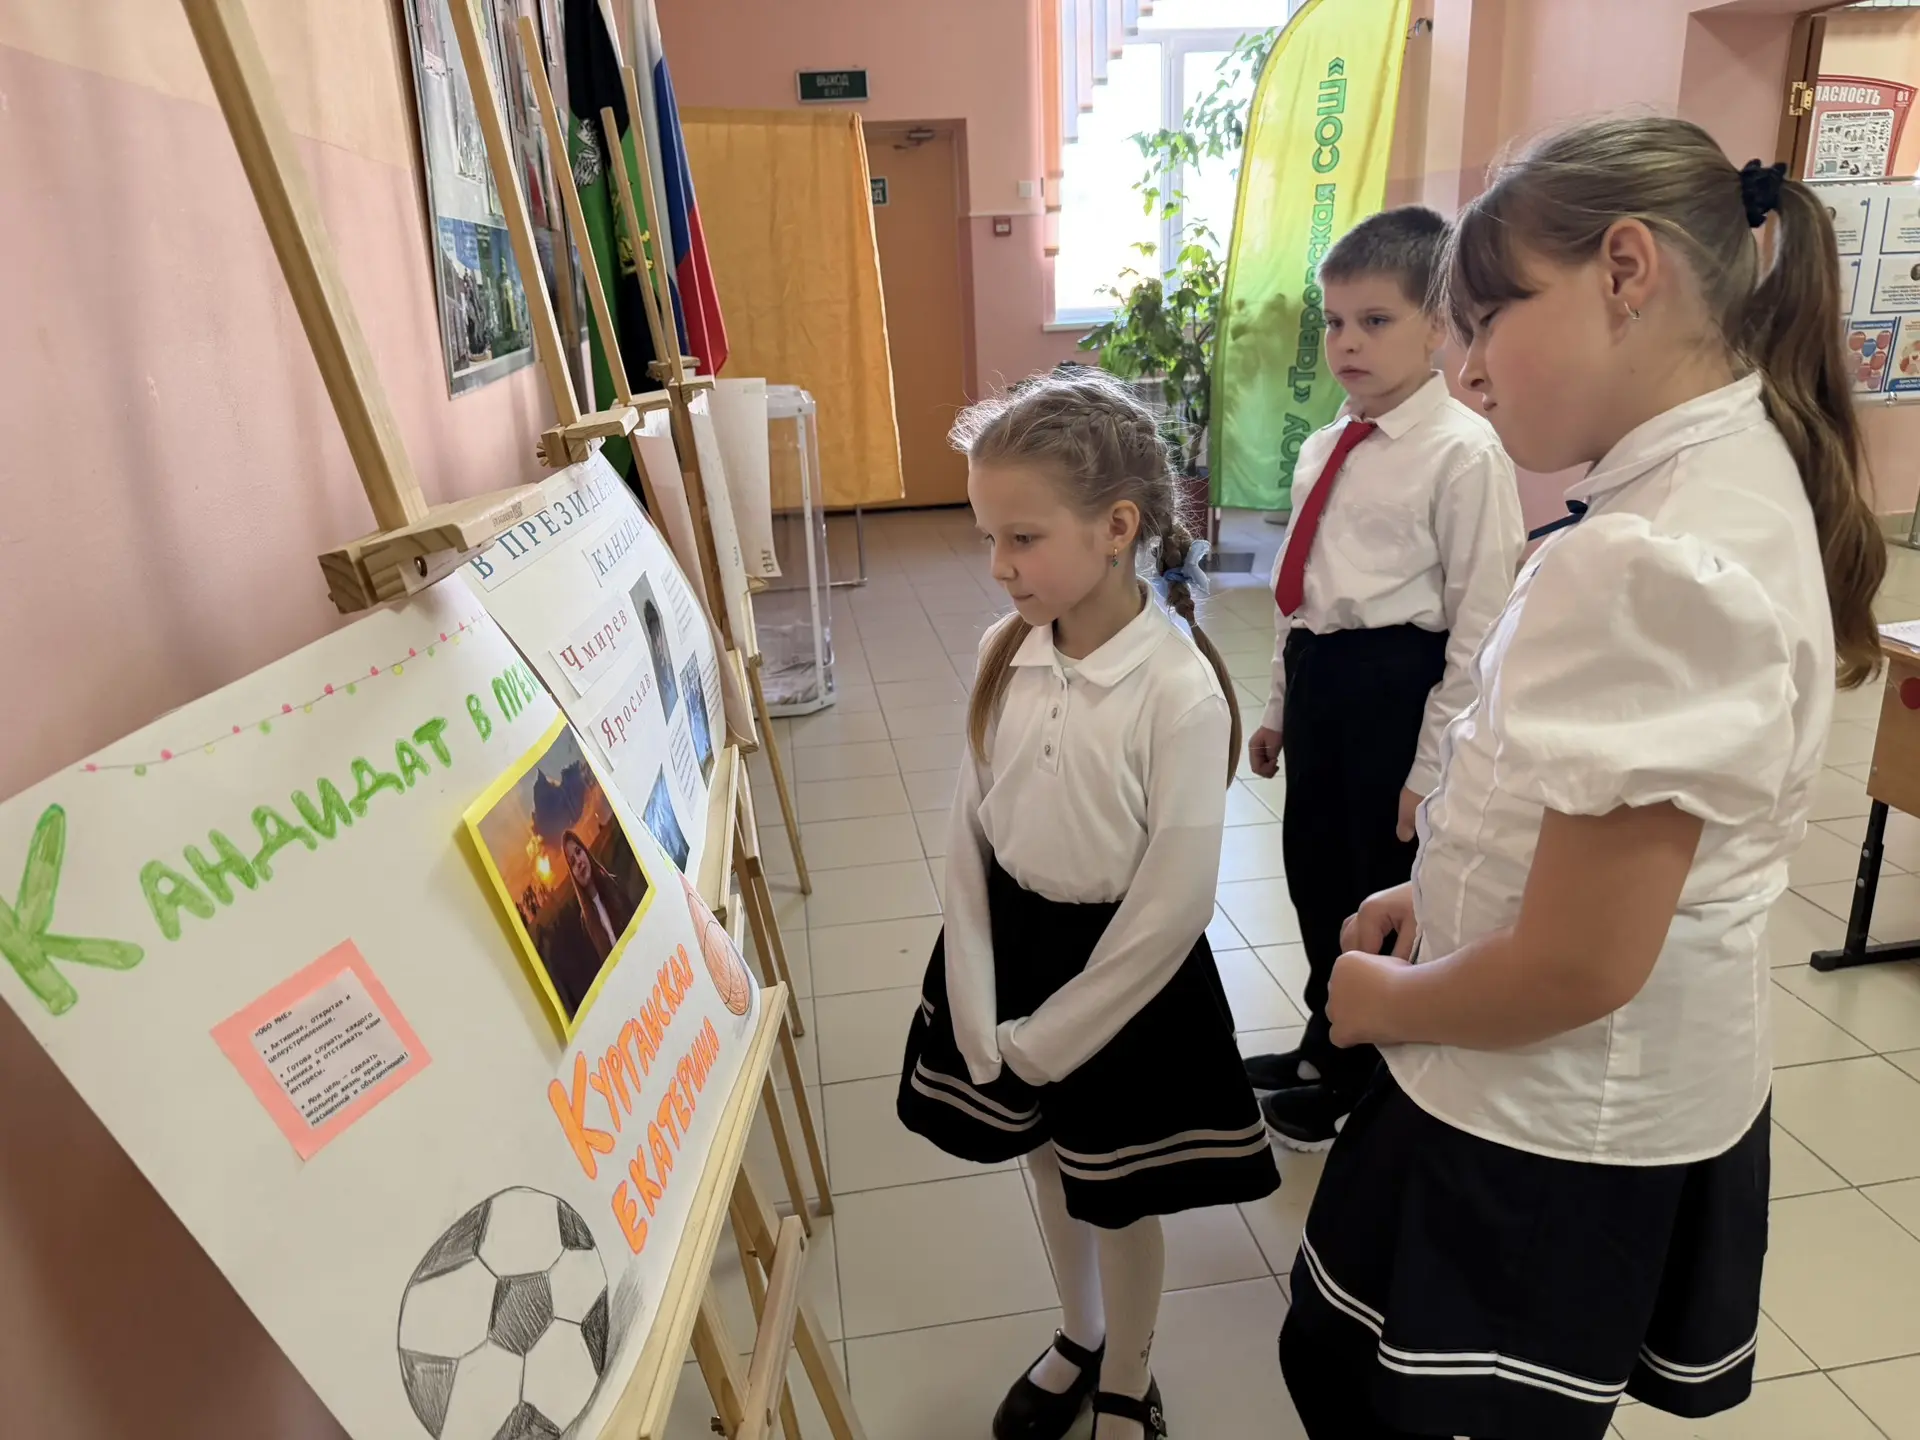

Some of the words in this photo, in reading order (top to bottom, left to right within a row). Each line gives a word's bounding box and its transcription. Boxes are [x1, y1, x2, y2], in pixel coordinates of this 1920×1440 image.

[816, 74, 849, 87] ВЫХОД
[1312, 57, 1347, 174] СОШ»
[469, 552, 494, 580] В
[560, 609, 628, 671] Чмирев
[601, 673, 652, 749] Ярослав
[268, 1017, 336, 1064] целеустремленная.
[271, 1024, 308, 1051] Активная,
[310, 999, 343, 1024] открытая
[274, 1010, 293, 1024] МНЕ»
[286, 1054, 312, 1073] Готова
[314, 1034, 343, 1055] слушать
[345, 1012, 373, 1034] каждого
[284, 1065, 313, 1088] ученика
[323, 1030, 363, 1060] отстаивать
[365, 1017, 381, 1031] наши
[290, 1068, 326, 1095] интересы.
[308, 1092, 322, 1105] Моя
[324, 1080, 341, 1095] цель
[350, 1053, 378, 1075] сделать
[306, 1092, 338, 1118] школьную
[341, 1077, 361, 1093] жизнь
[363, 1059, 387, 1077] яркой,
[311, 1094, 350, 1126] насыщенной
[361, 1051, 408, 1090] объединяющей!
[611, 1015, 720, 1255] ЕКАТЕРИНА
